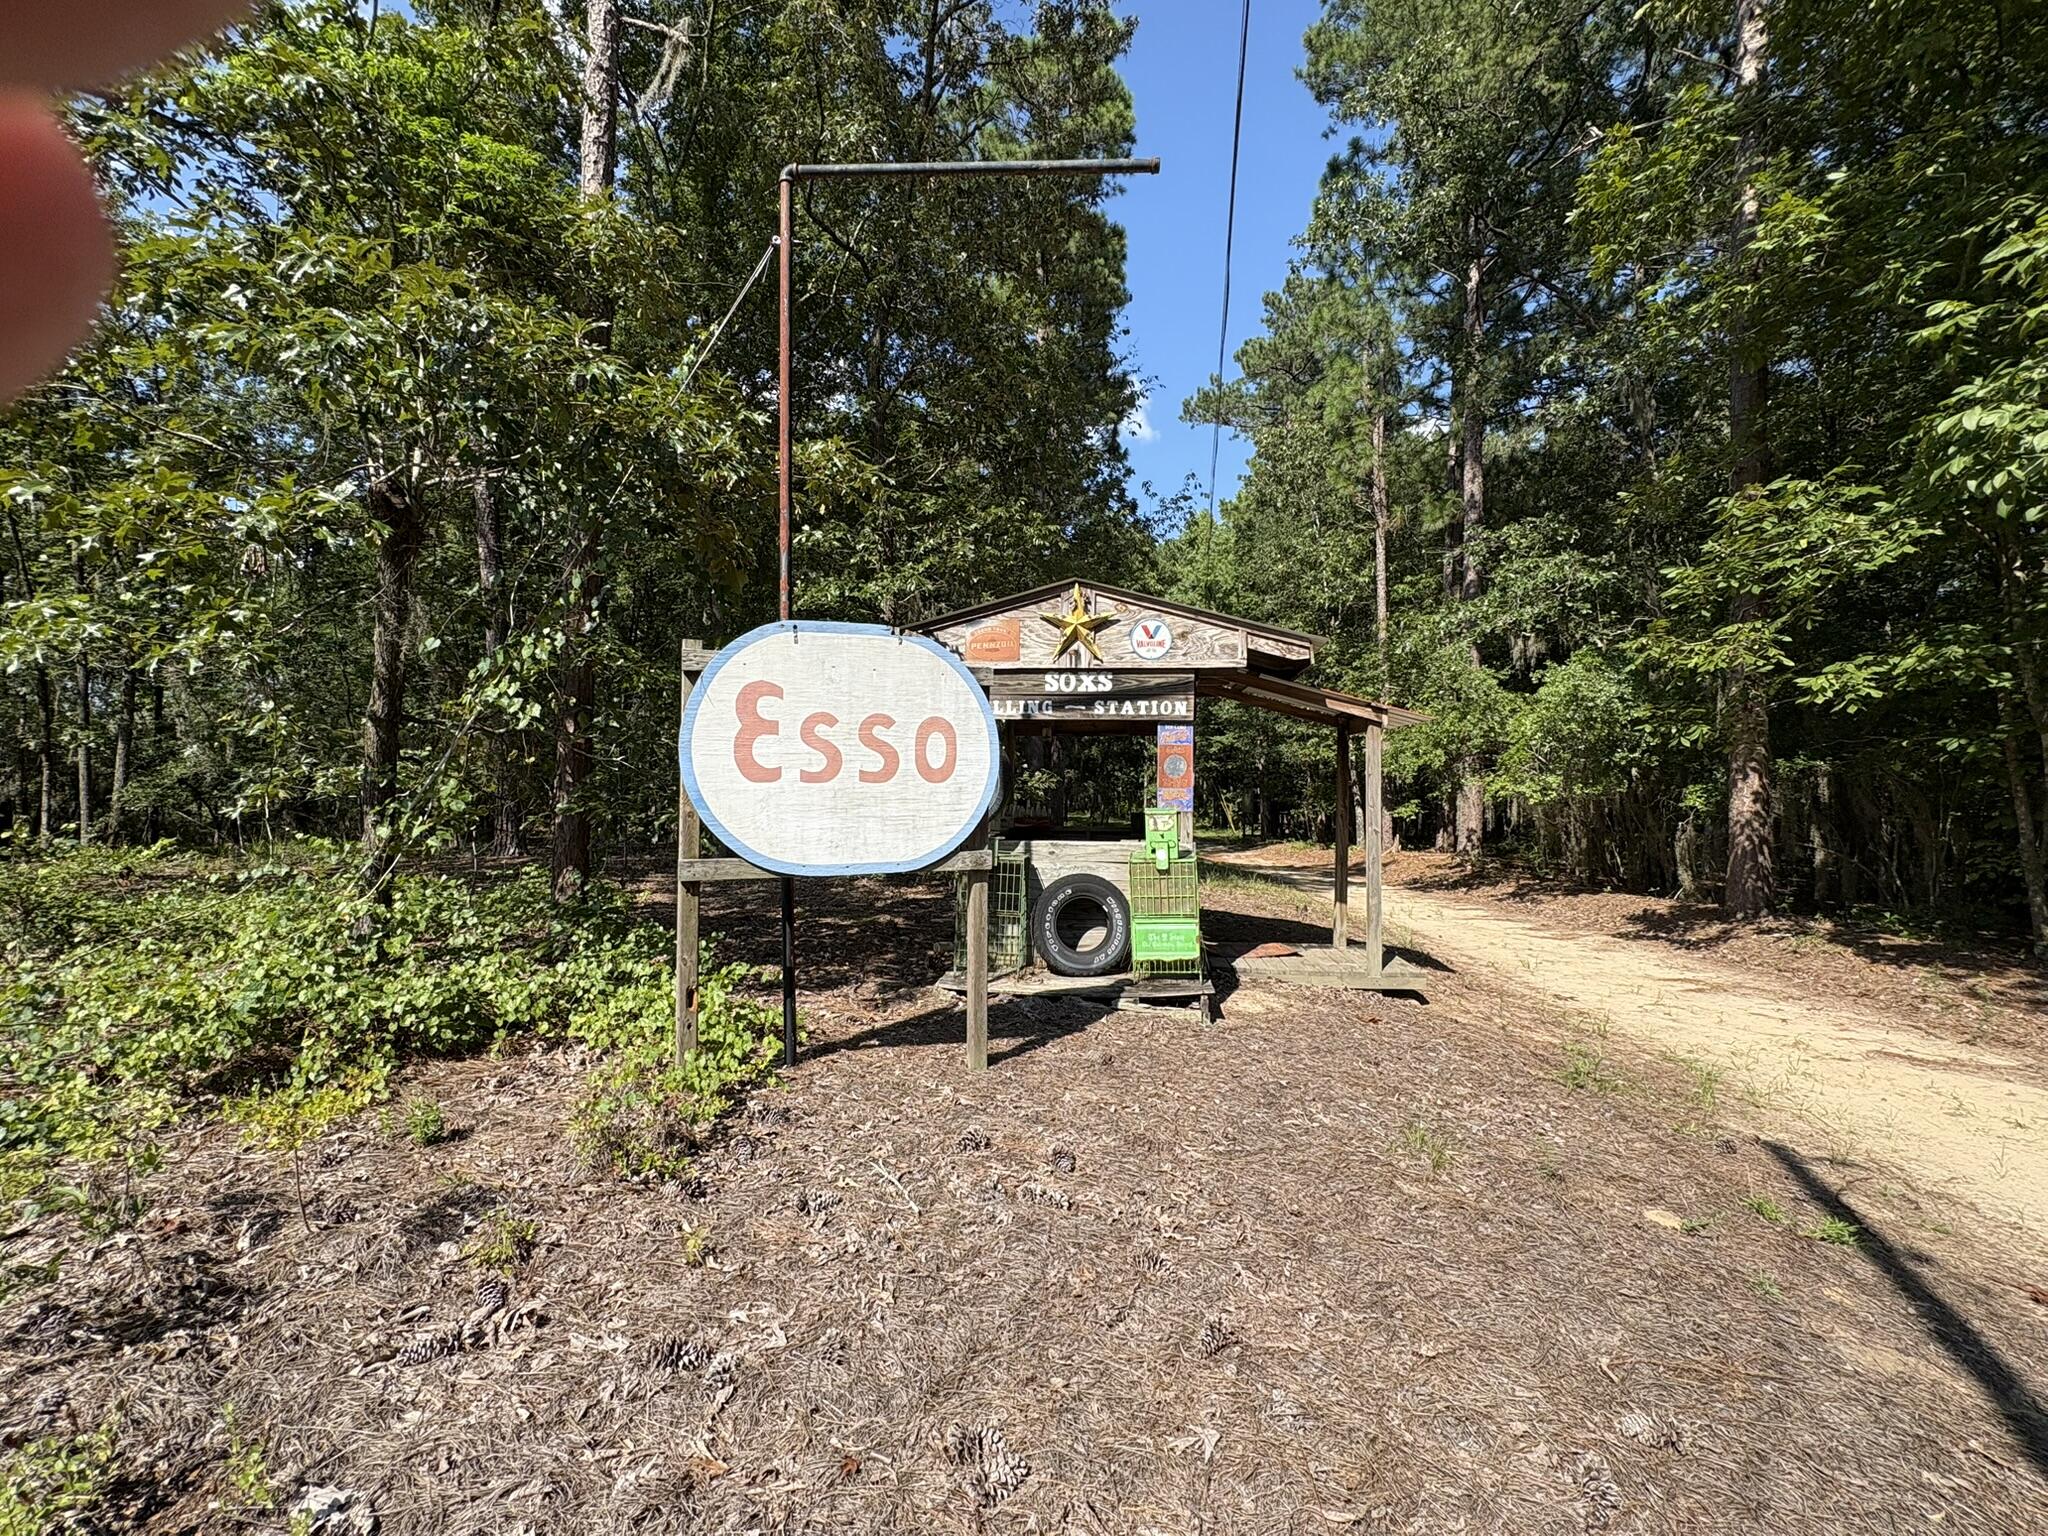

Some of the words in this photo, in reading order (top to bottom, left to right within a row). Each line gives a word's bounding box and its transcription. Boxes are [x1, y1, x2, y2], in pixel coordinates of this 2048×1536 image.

[970, 640, 1015, 650] PENNZOIL
[1044, 672, 1113, 692] SOXS
[993, 700, 1053, 715] LLING
[1094, 700, 1188, 716] STATION
